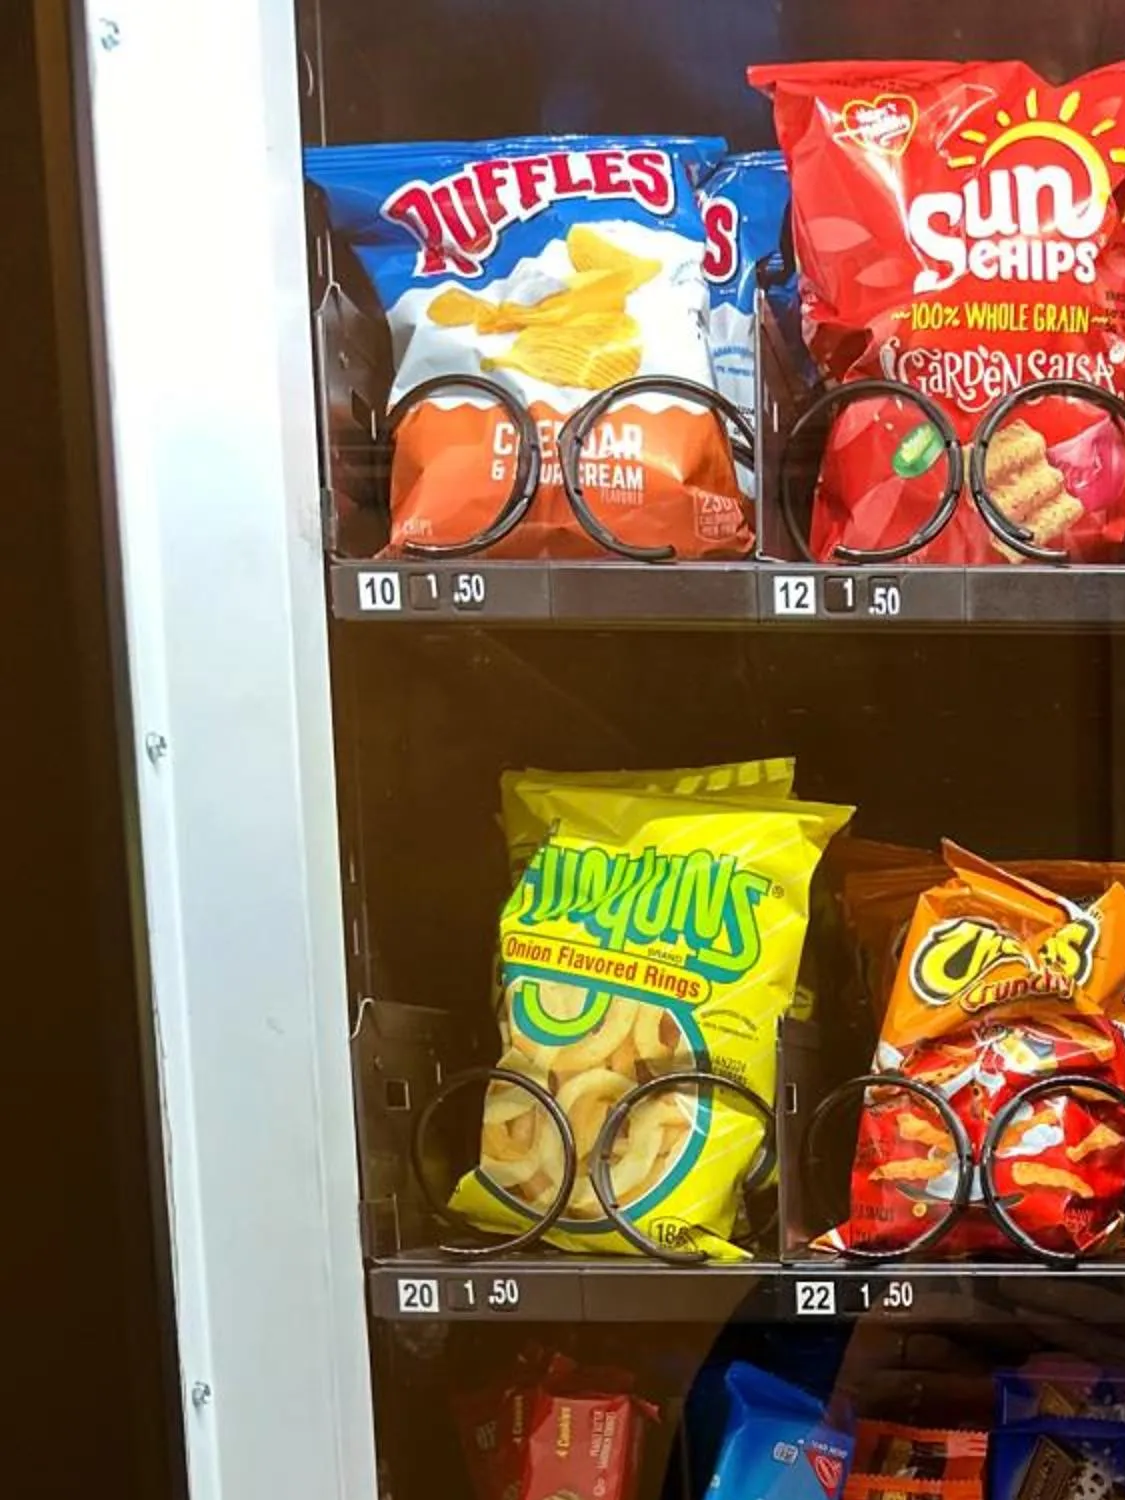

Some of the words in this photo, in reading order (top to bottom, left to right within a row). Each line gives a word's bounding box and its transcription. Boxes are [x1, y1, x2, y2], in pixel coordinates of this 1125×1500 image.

[386, 151, 673, 276] RUFFLES
[910, 303, 961, 330] 100%
[965, 302, 1029, 331] WHOLE
[1033, 303, 1090, 334] GRAIN
[365, 577, 395, 605] 10
[779, 581, 809, 609] 12
[505, 935, 552, 963] Onion
[557, 945, 639, 981] Flavored
[643, 966, 701, 999] Rings
[401, 1283, 433, 1314] 20
[801, 1285, 831, 1310] 22
